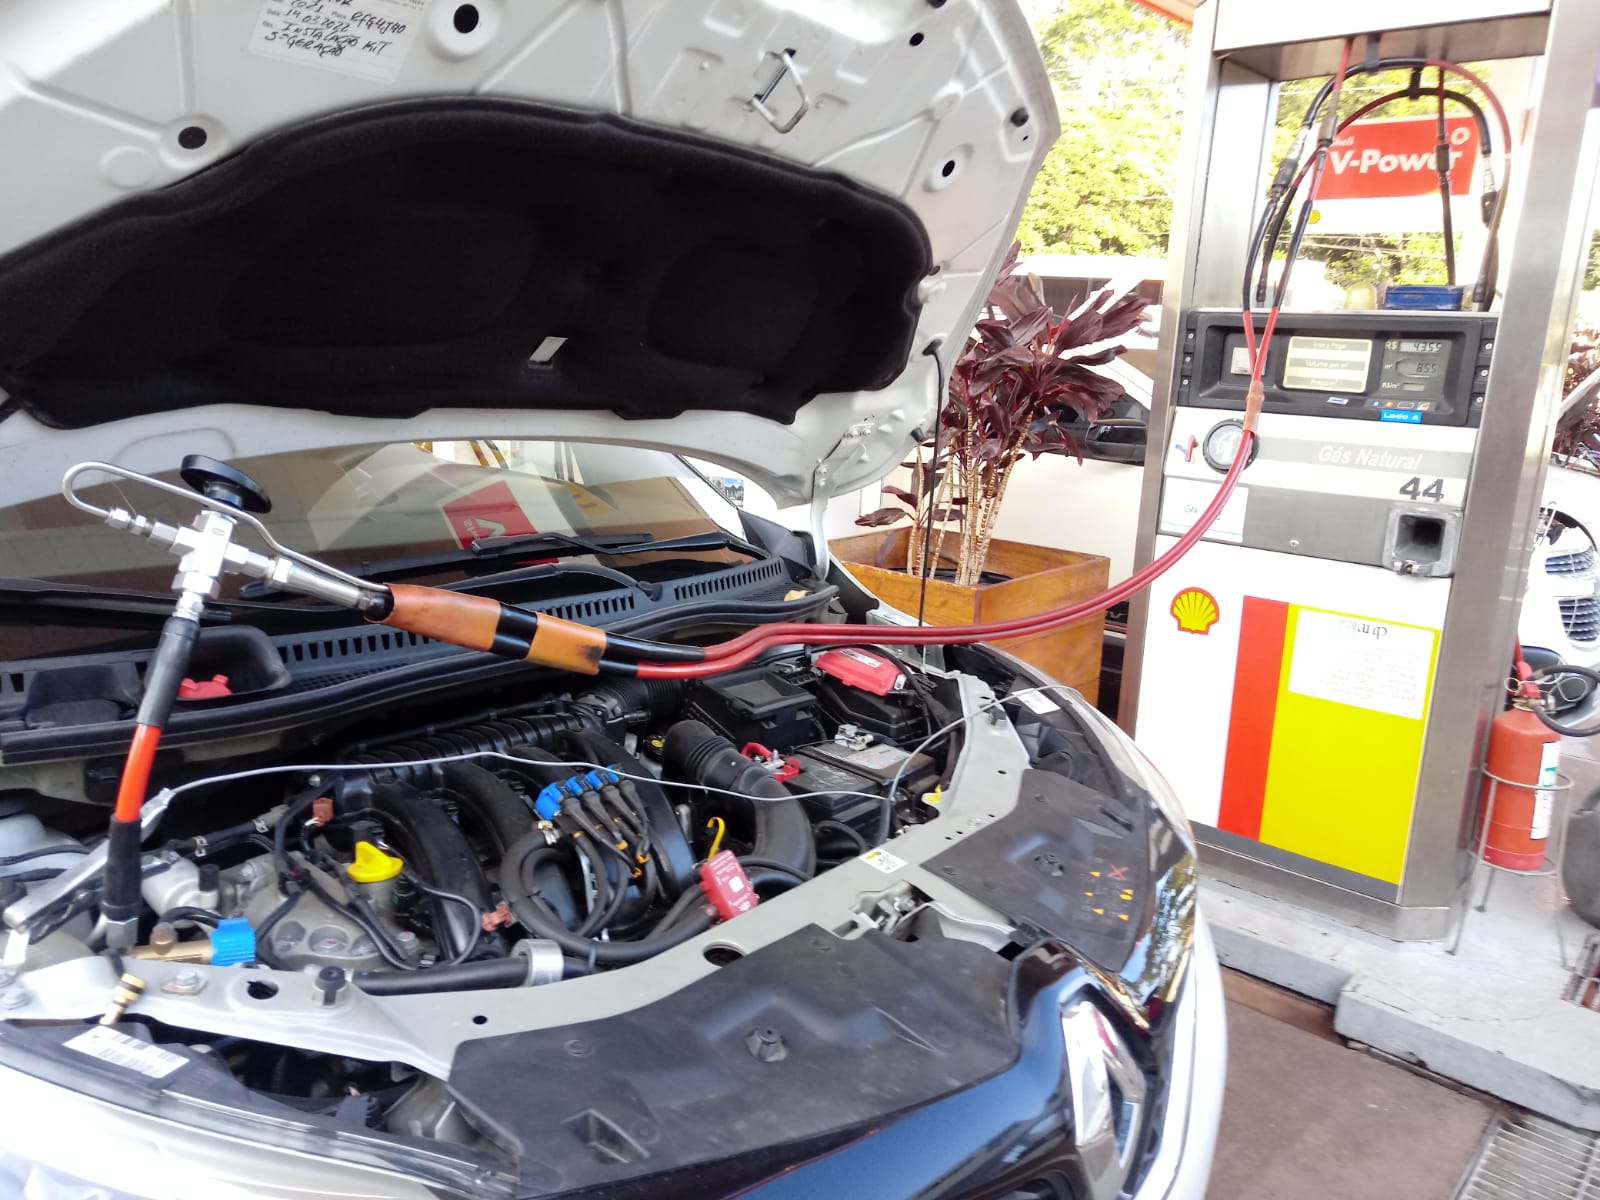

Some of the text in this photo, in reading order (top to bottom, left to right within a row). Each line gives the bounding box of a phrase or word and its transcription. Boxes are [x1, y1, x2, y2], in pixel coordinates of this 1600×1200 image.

[1318, 445, 1424, 471] Gás Natural
[1399, 476, 1445, 502] 44
